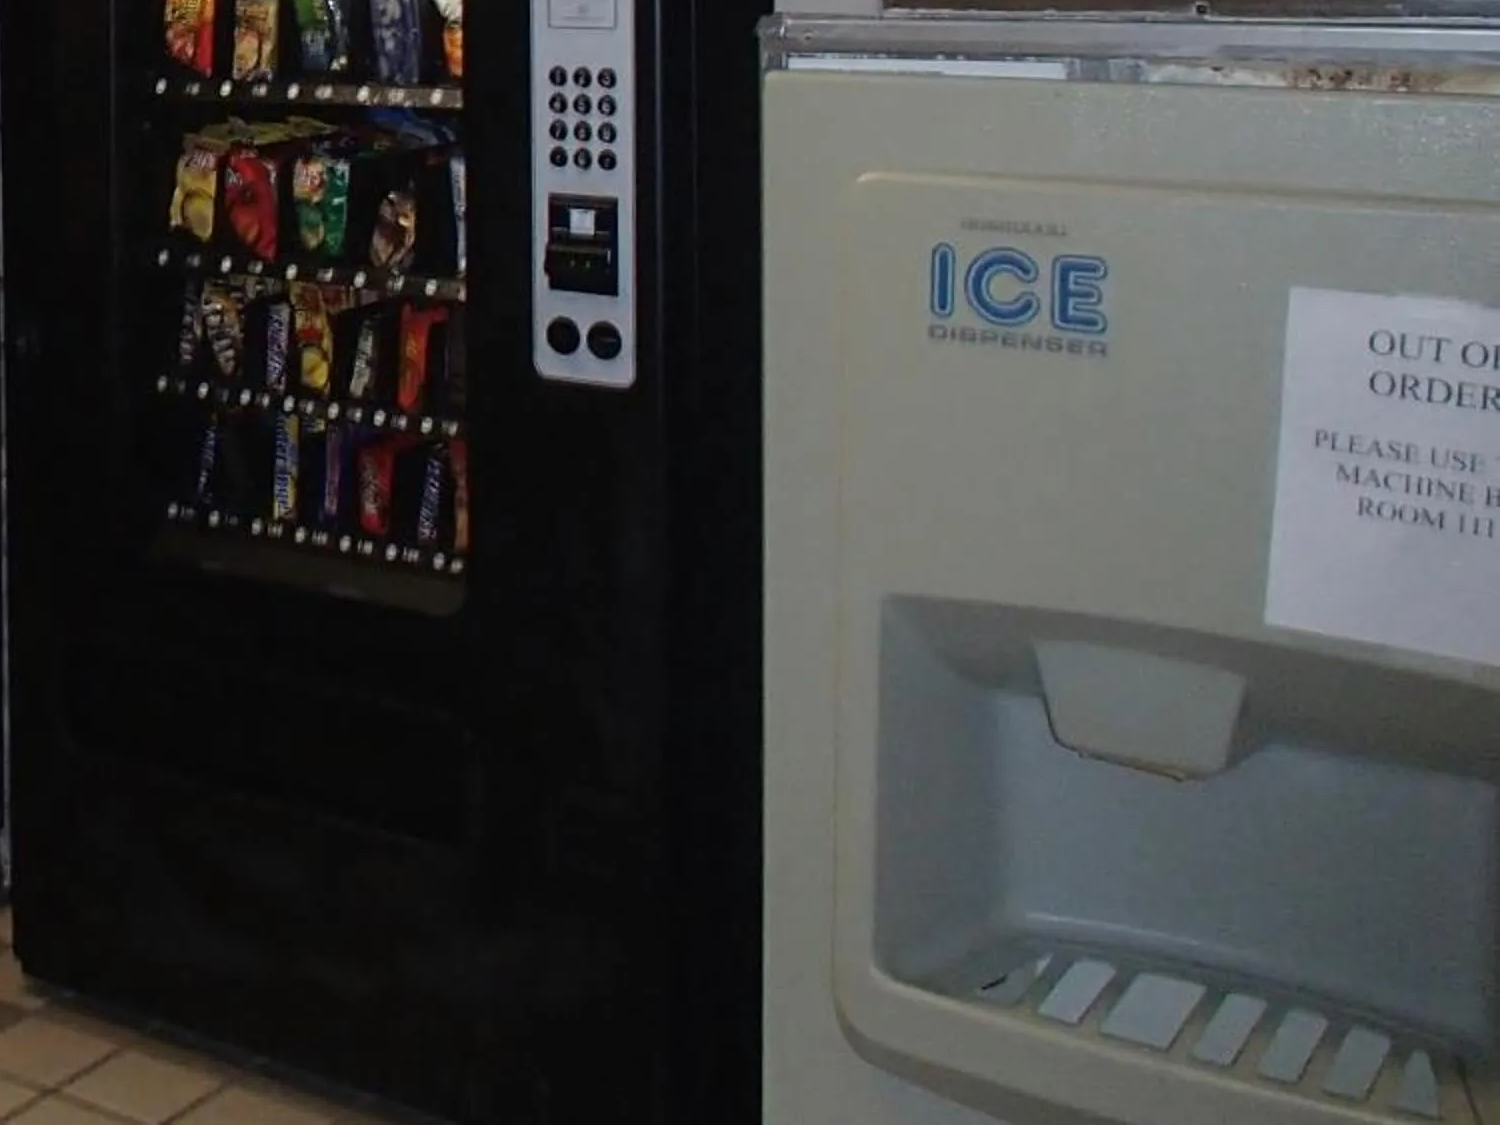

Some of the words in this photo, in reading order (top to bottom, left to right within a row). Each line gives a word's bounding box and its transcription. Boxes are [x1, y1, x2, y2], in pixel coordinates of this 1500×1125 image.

[930, 242, 1108, 334] ICE
[927, 324, 1108, 357] DISPENSER
[1368, 329, 1452, 363] OUT
[1368, 370, 1500, 412] ORDER
[1314, 428, 1419, 465] PLEASE
[1430, 446, 1485, 474] USE
[1335, 462, 1474, 505] MACHINE
[1356, 495, 1446, 530] ROOM
